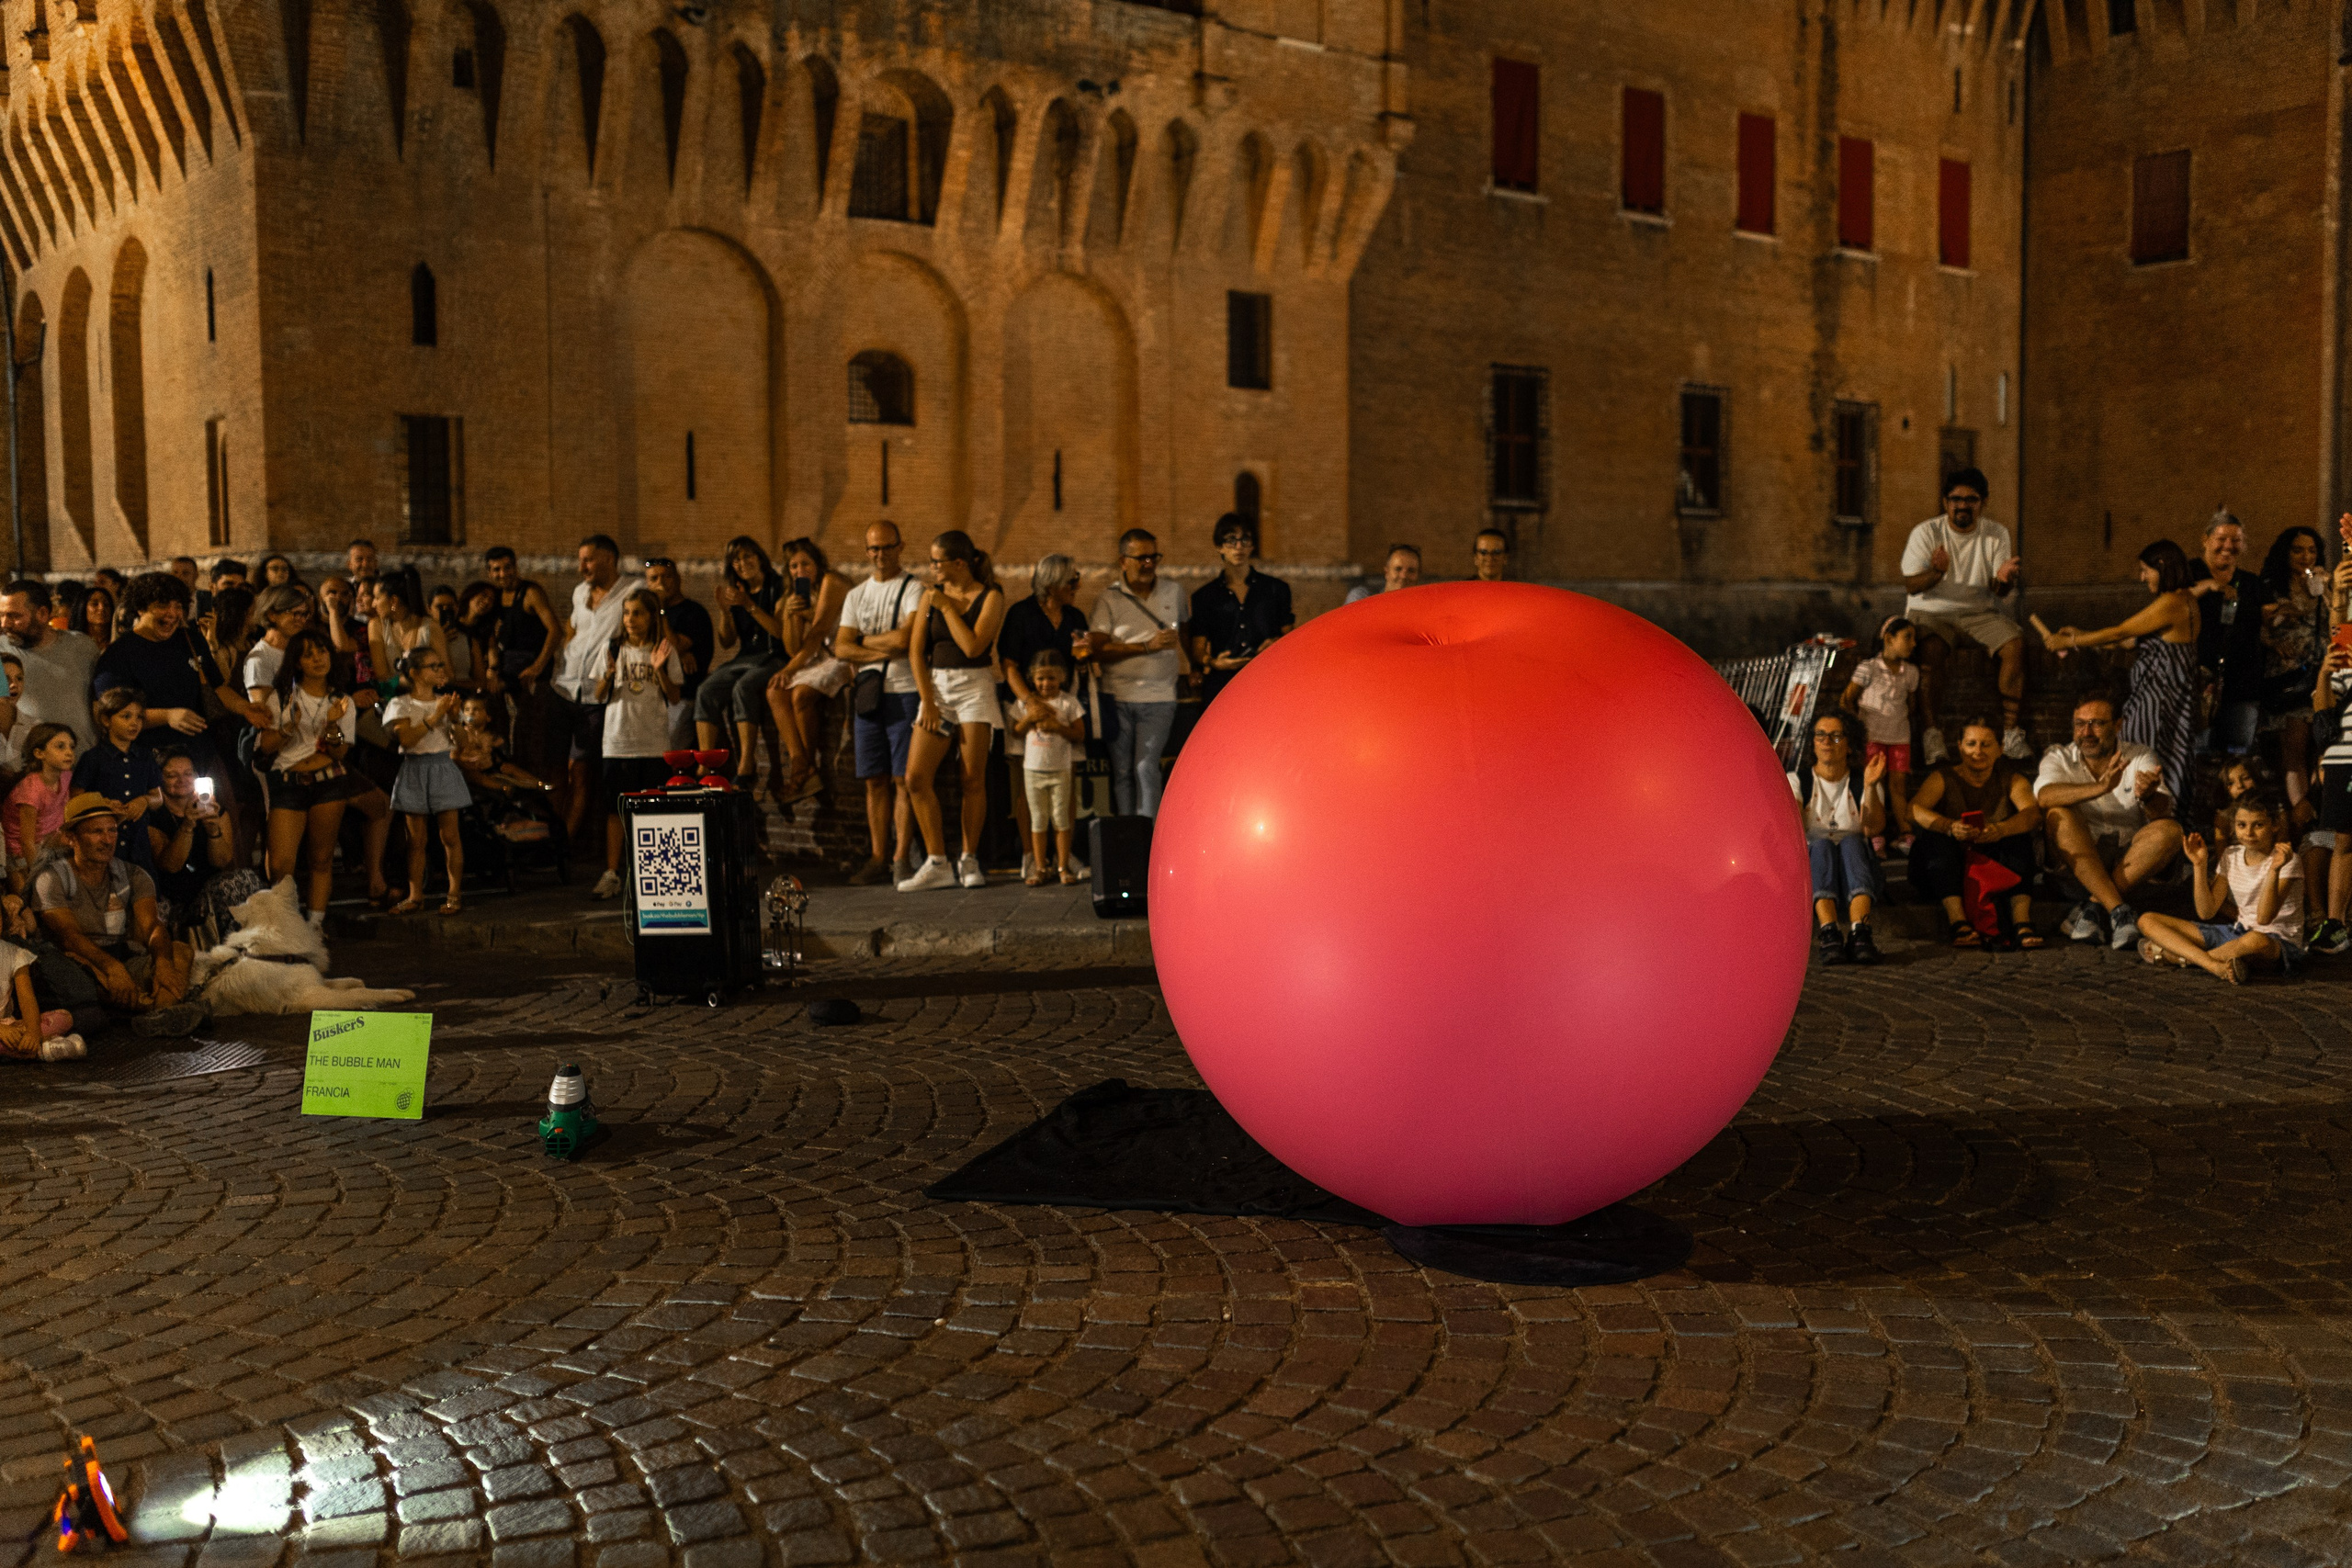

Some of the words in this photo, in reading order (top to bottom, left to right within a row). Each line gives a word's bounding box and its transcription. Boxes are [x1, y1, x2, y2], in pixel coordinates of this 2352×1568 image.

[310, 1055, 329, 1066] THE
[331, 1055, 374, 1068] BUBBLE
[376, 1057, 401, 1069] MAN
[306, 1086, 351, 1098] FRANCIA
